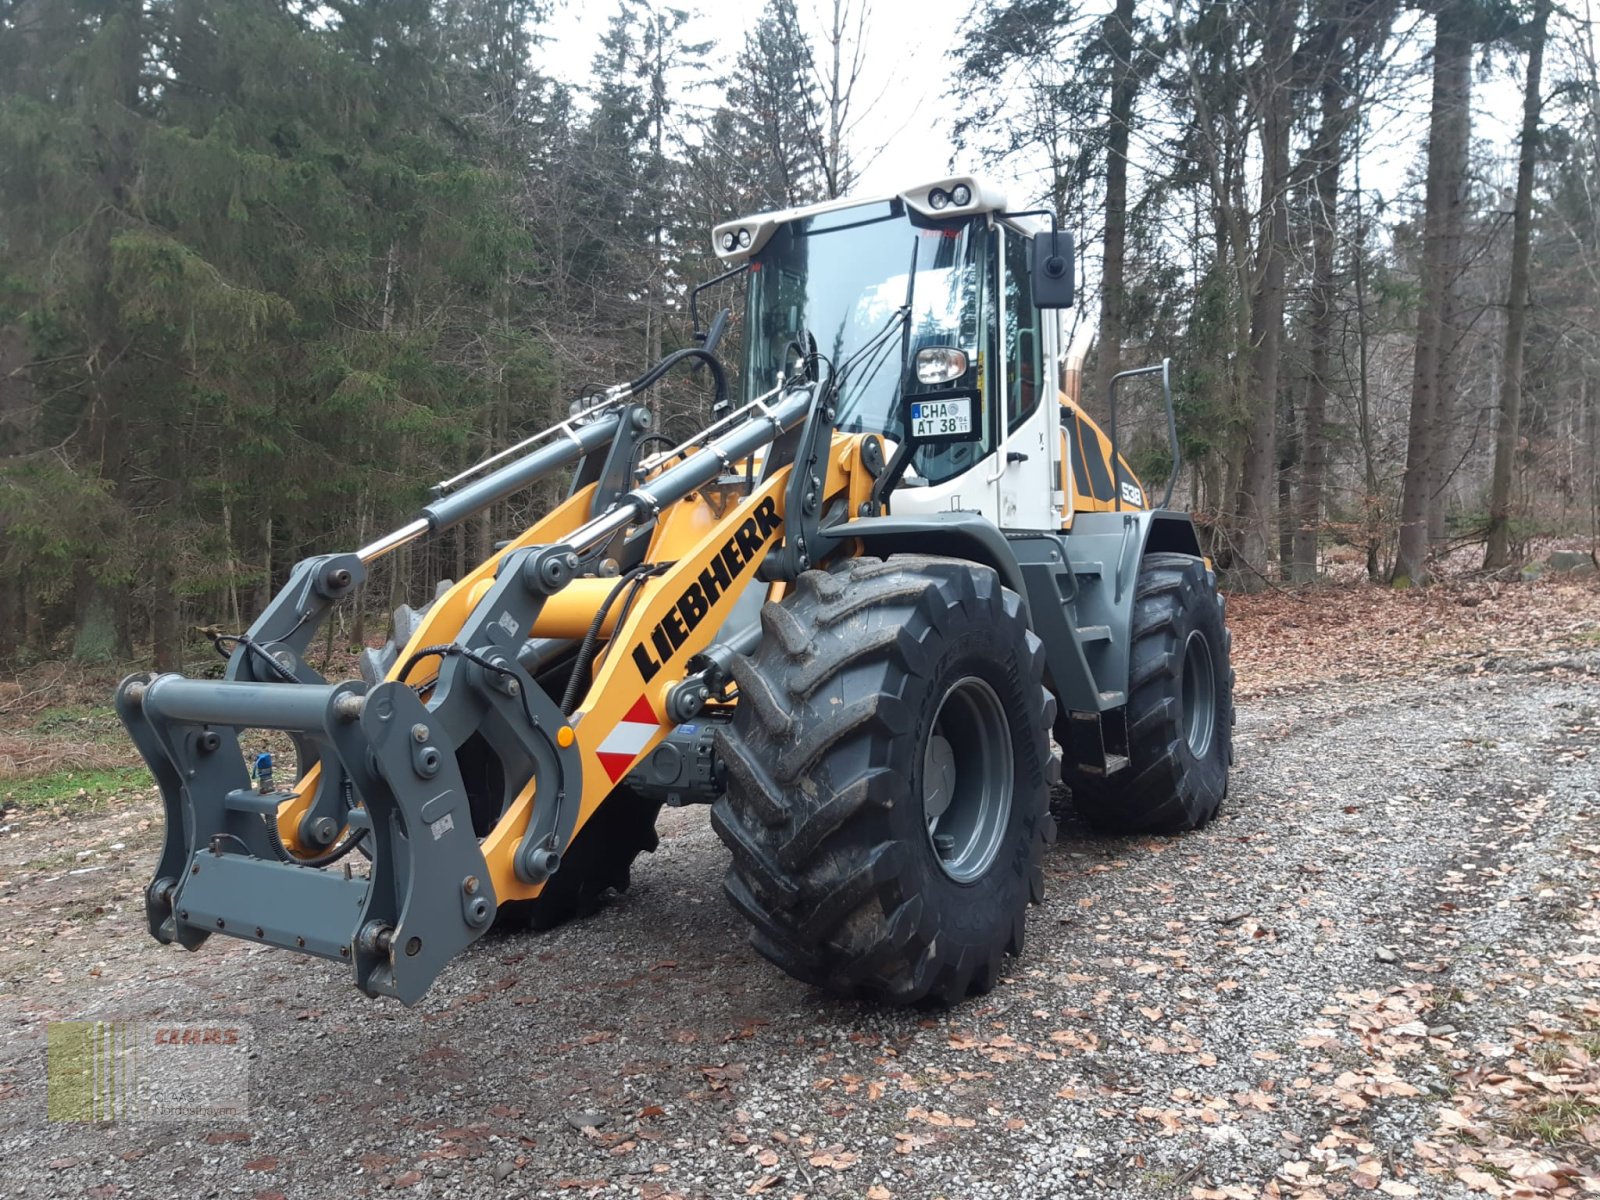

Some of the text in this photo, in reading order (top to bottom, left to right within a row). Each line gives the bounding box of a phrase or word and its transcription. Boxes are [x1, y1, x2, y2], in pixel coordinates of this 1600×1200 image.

[921, 404, 948, 419] CHA
[918, 418, 957, 435] AT 38
[1121, 481, 1142, 506] 538
[632, 496, 783, 684] LIEBHERR
